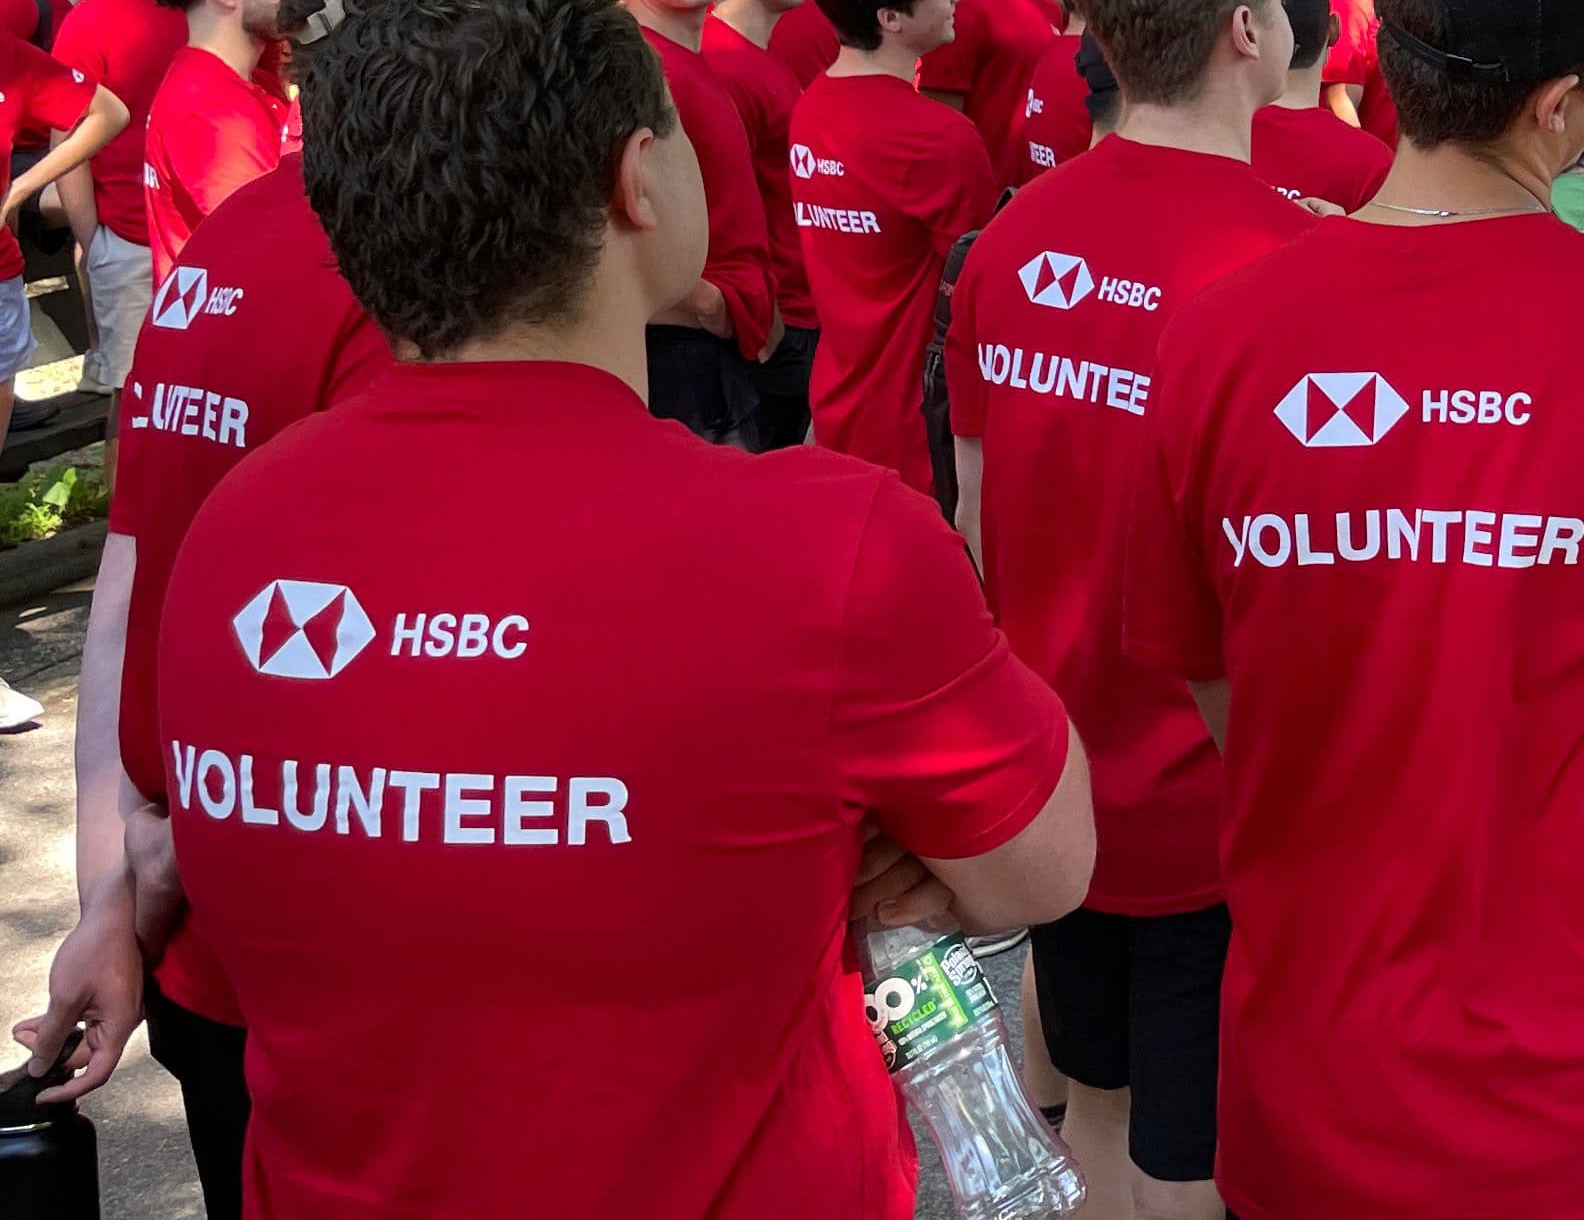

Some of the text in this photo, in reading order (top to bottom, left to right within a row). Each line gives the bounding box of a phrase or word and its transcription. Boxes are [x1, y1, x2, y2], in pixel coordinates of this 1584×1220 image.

[816, 158, 844, 176] HSBC
[793, 202, 881, 234] LUNTEER
[1097, 276, 1162, 311] HSBC
[978, 342, 1152, 416] VOLUNTEE
[1422, 389, 1532, 426] HSBC
[390, 612, 530, 659] HSBC
[171, 739, 632, 845] VOLUNTEER
